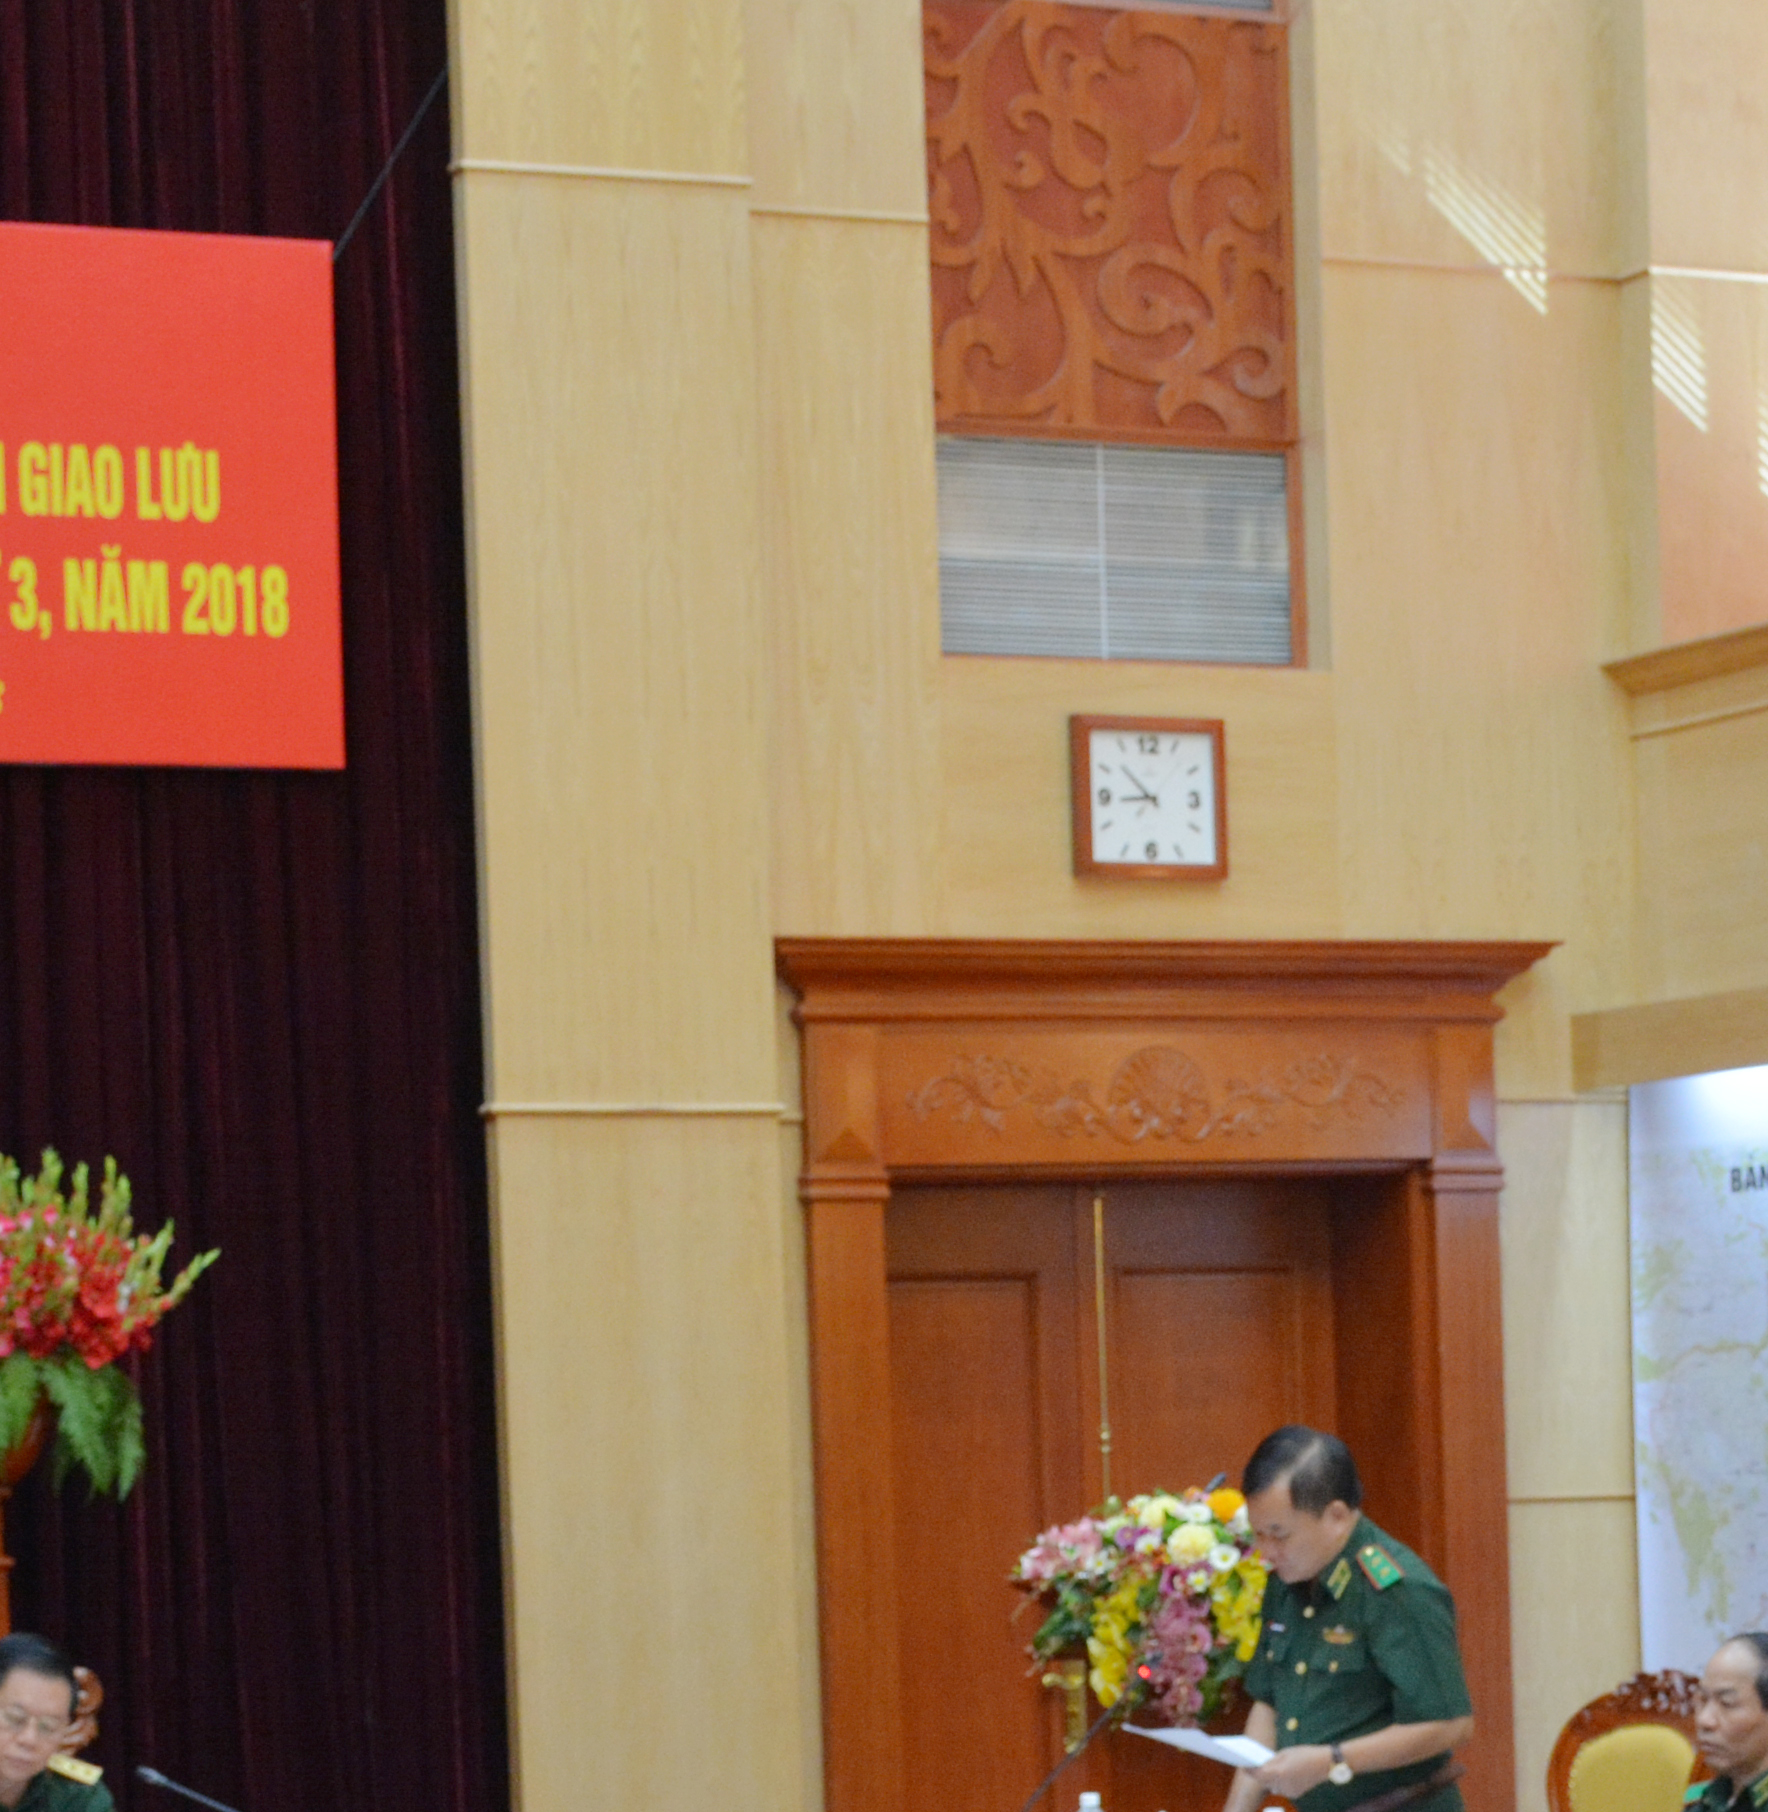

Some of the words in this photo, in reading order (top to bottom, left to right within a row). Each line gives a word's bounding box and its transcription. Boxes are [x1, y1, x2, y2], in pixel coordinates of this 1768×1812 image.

[18, 441, 124, 520] GIAO
[135, 441, 221, 523] LƯU
[9, 556, 52, 640] 3,
[63, 545, 170, 634] NĂM
[181, 562, 290, 639] 2018
[1138, 736, 1159, 754] 12
[1098, 788, 1112, 806] 9
[1188, 791, 1201, 810] 3
[1144, 842, 1158, 860] 6
